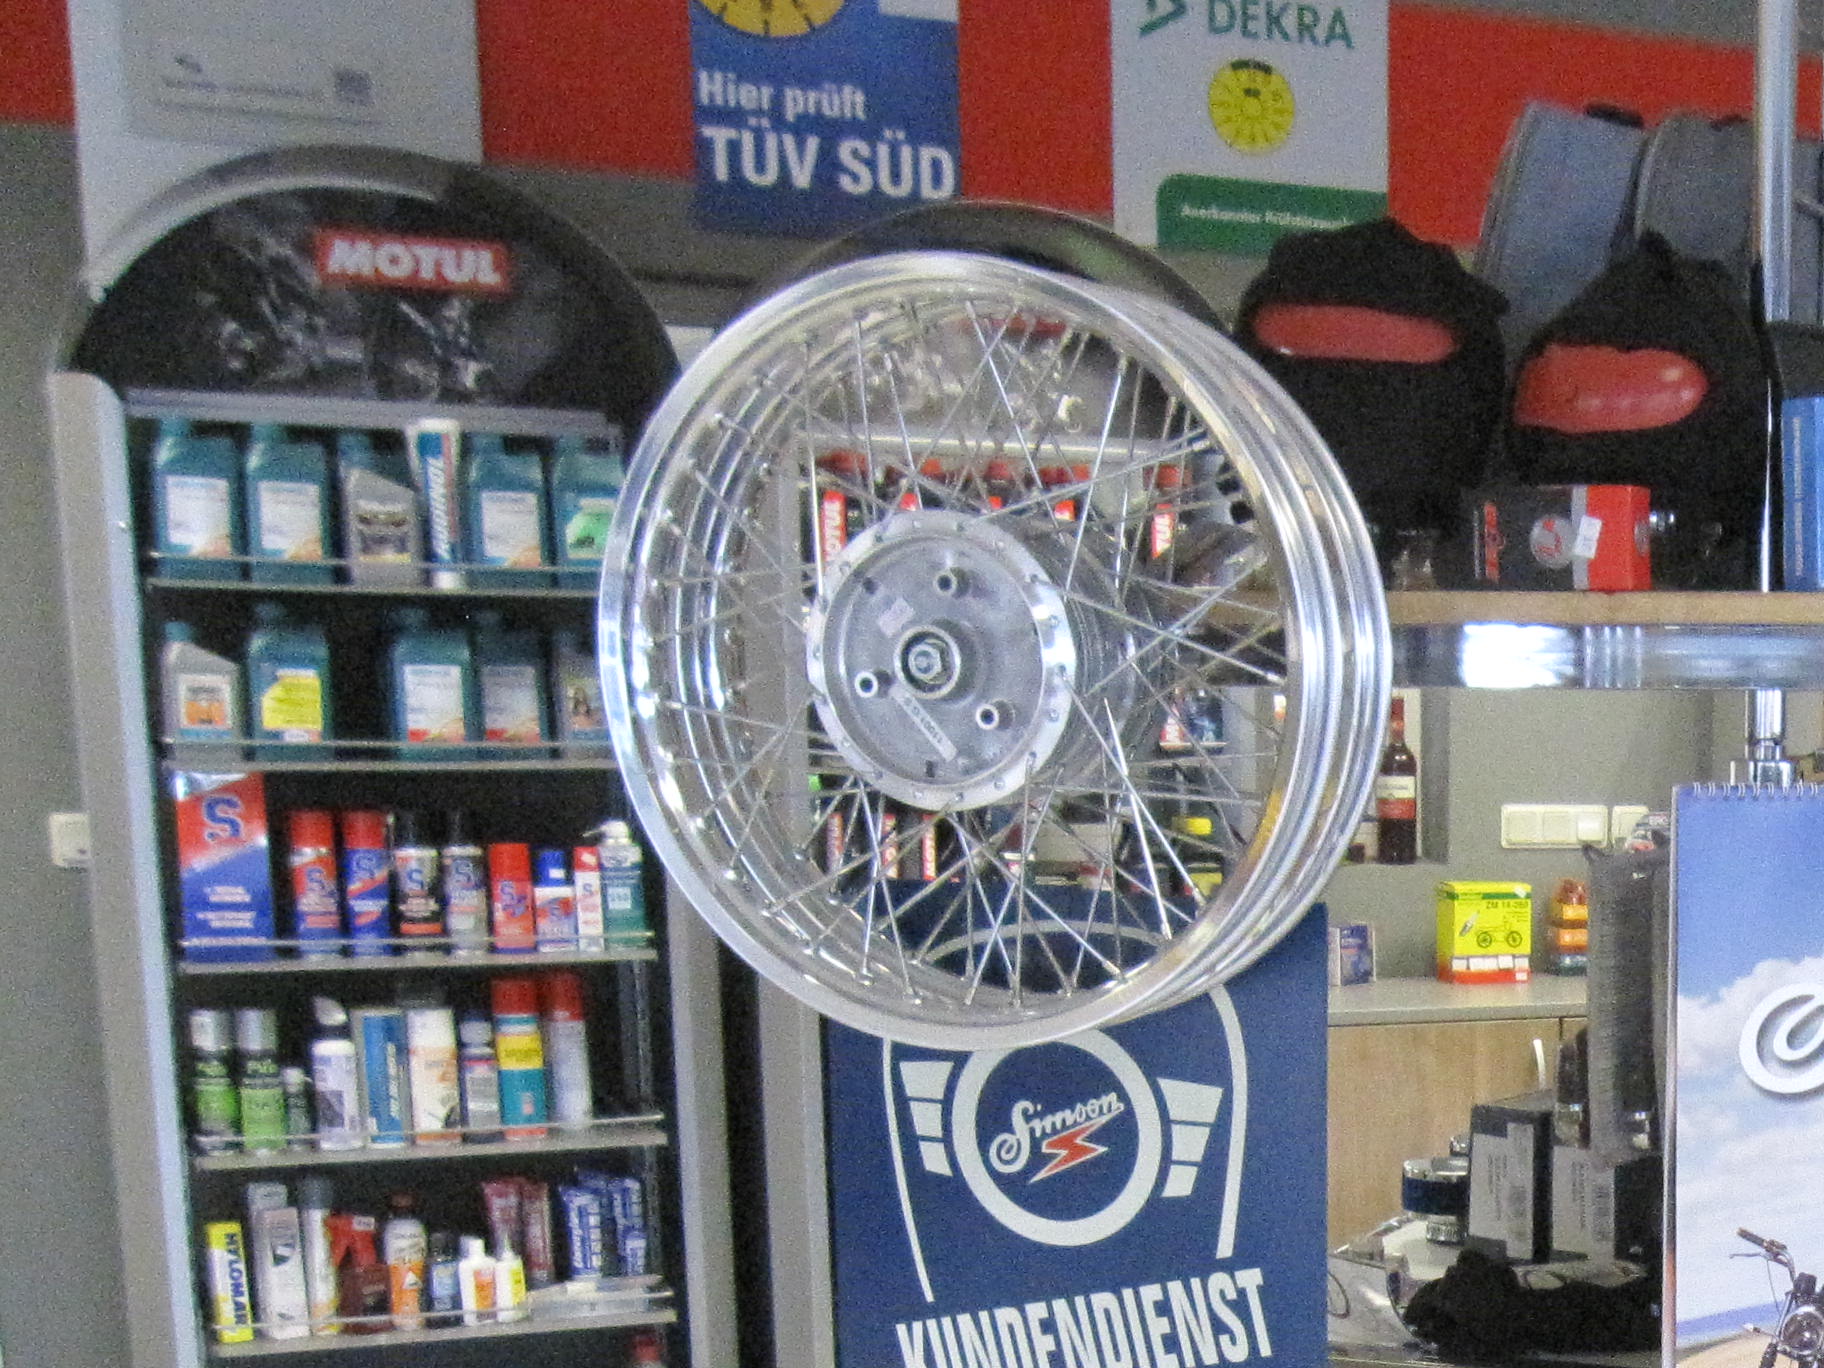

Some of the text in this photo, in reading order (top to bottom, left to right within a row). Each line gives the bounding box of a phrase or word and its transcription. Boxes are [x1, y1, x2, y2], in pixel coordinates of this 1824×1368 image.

[1207, 0, 1354, 49] DEKRA
[699, 70, 867, 123] Hier prüft
[700, 116, 956, 200] TÜV SÜD
[327, 239, 502, 286] MOTUL
[989, 1091, 1126, 1175] Simson
[223, 1232, 250, 1325] HYLOMAR
